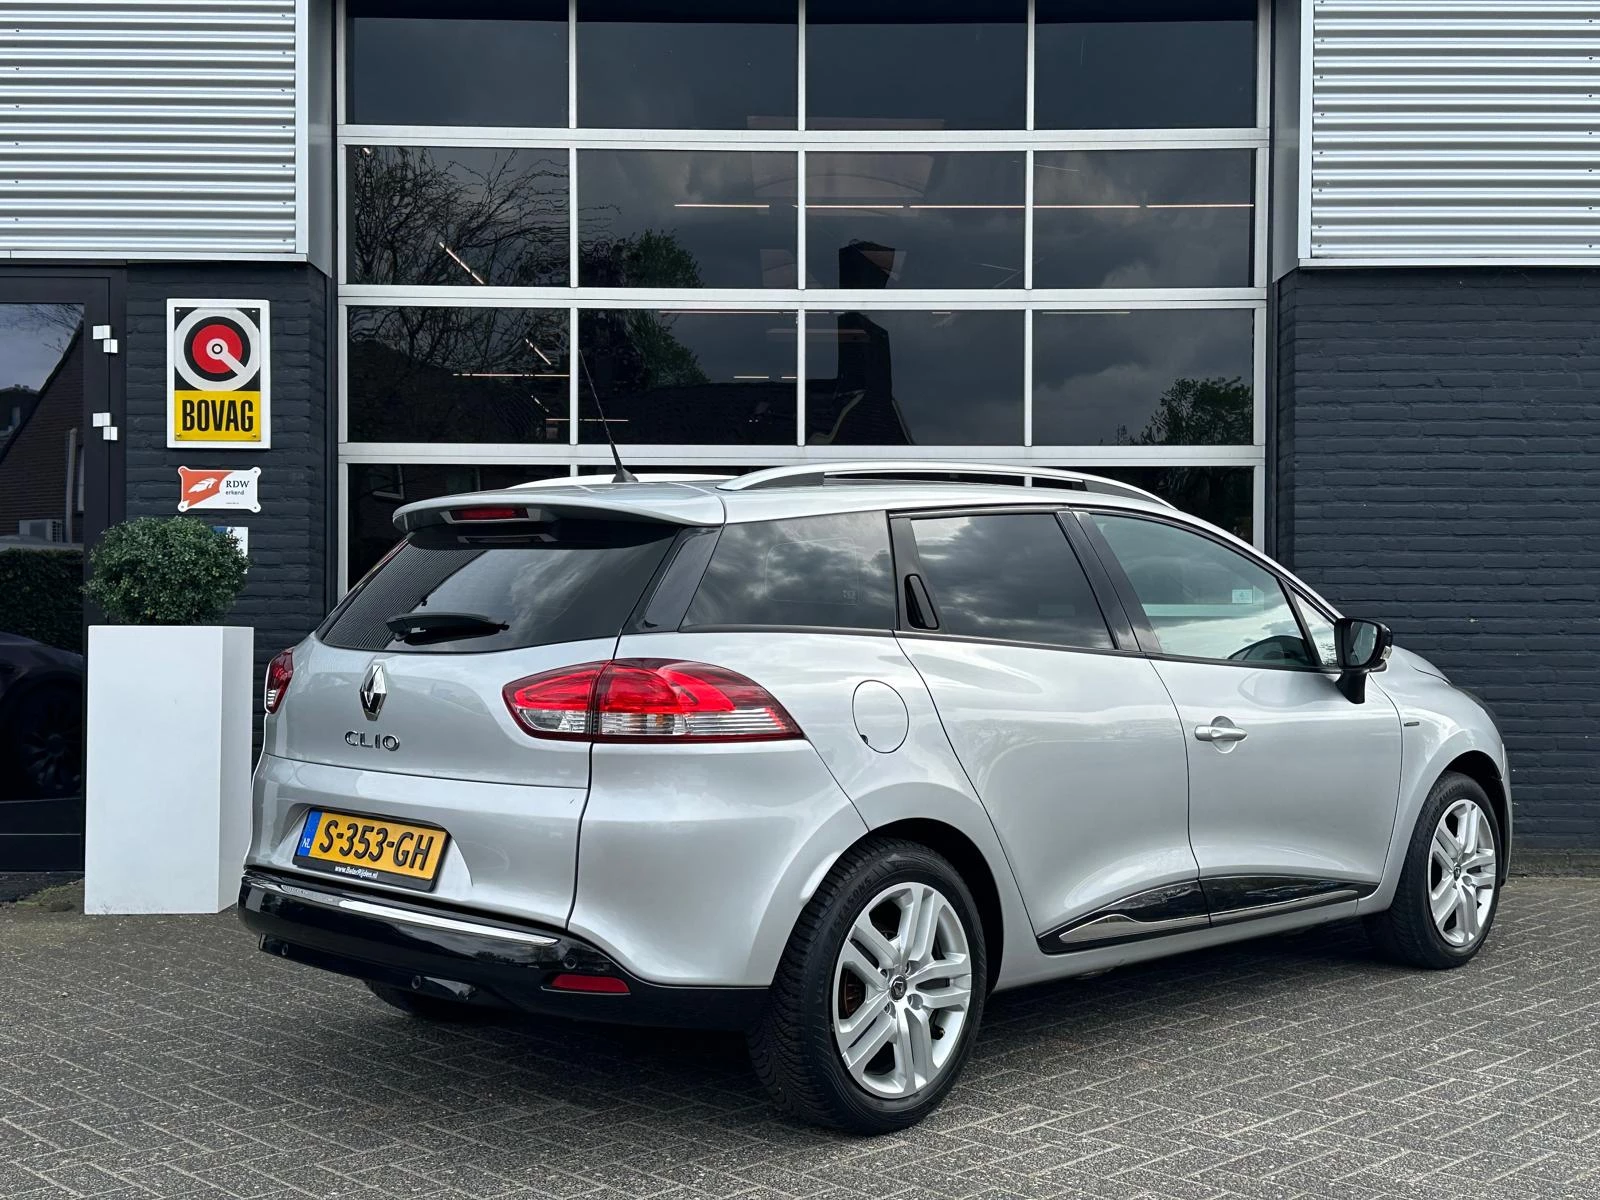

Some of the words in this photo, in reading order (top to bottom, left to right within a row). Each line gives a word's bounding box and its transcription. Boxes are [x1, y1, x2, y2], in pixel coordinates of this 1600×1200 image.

[182, 399, 254, 432] BOVAG
[226, 480, 250, 488] RDW
[344, 730, 400, 751] CLIO
[301, 836, 311, 849] NL
[318, 819, 434, 871] S-353-GH
